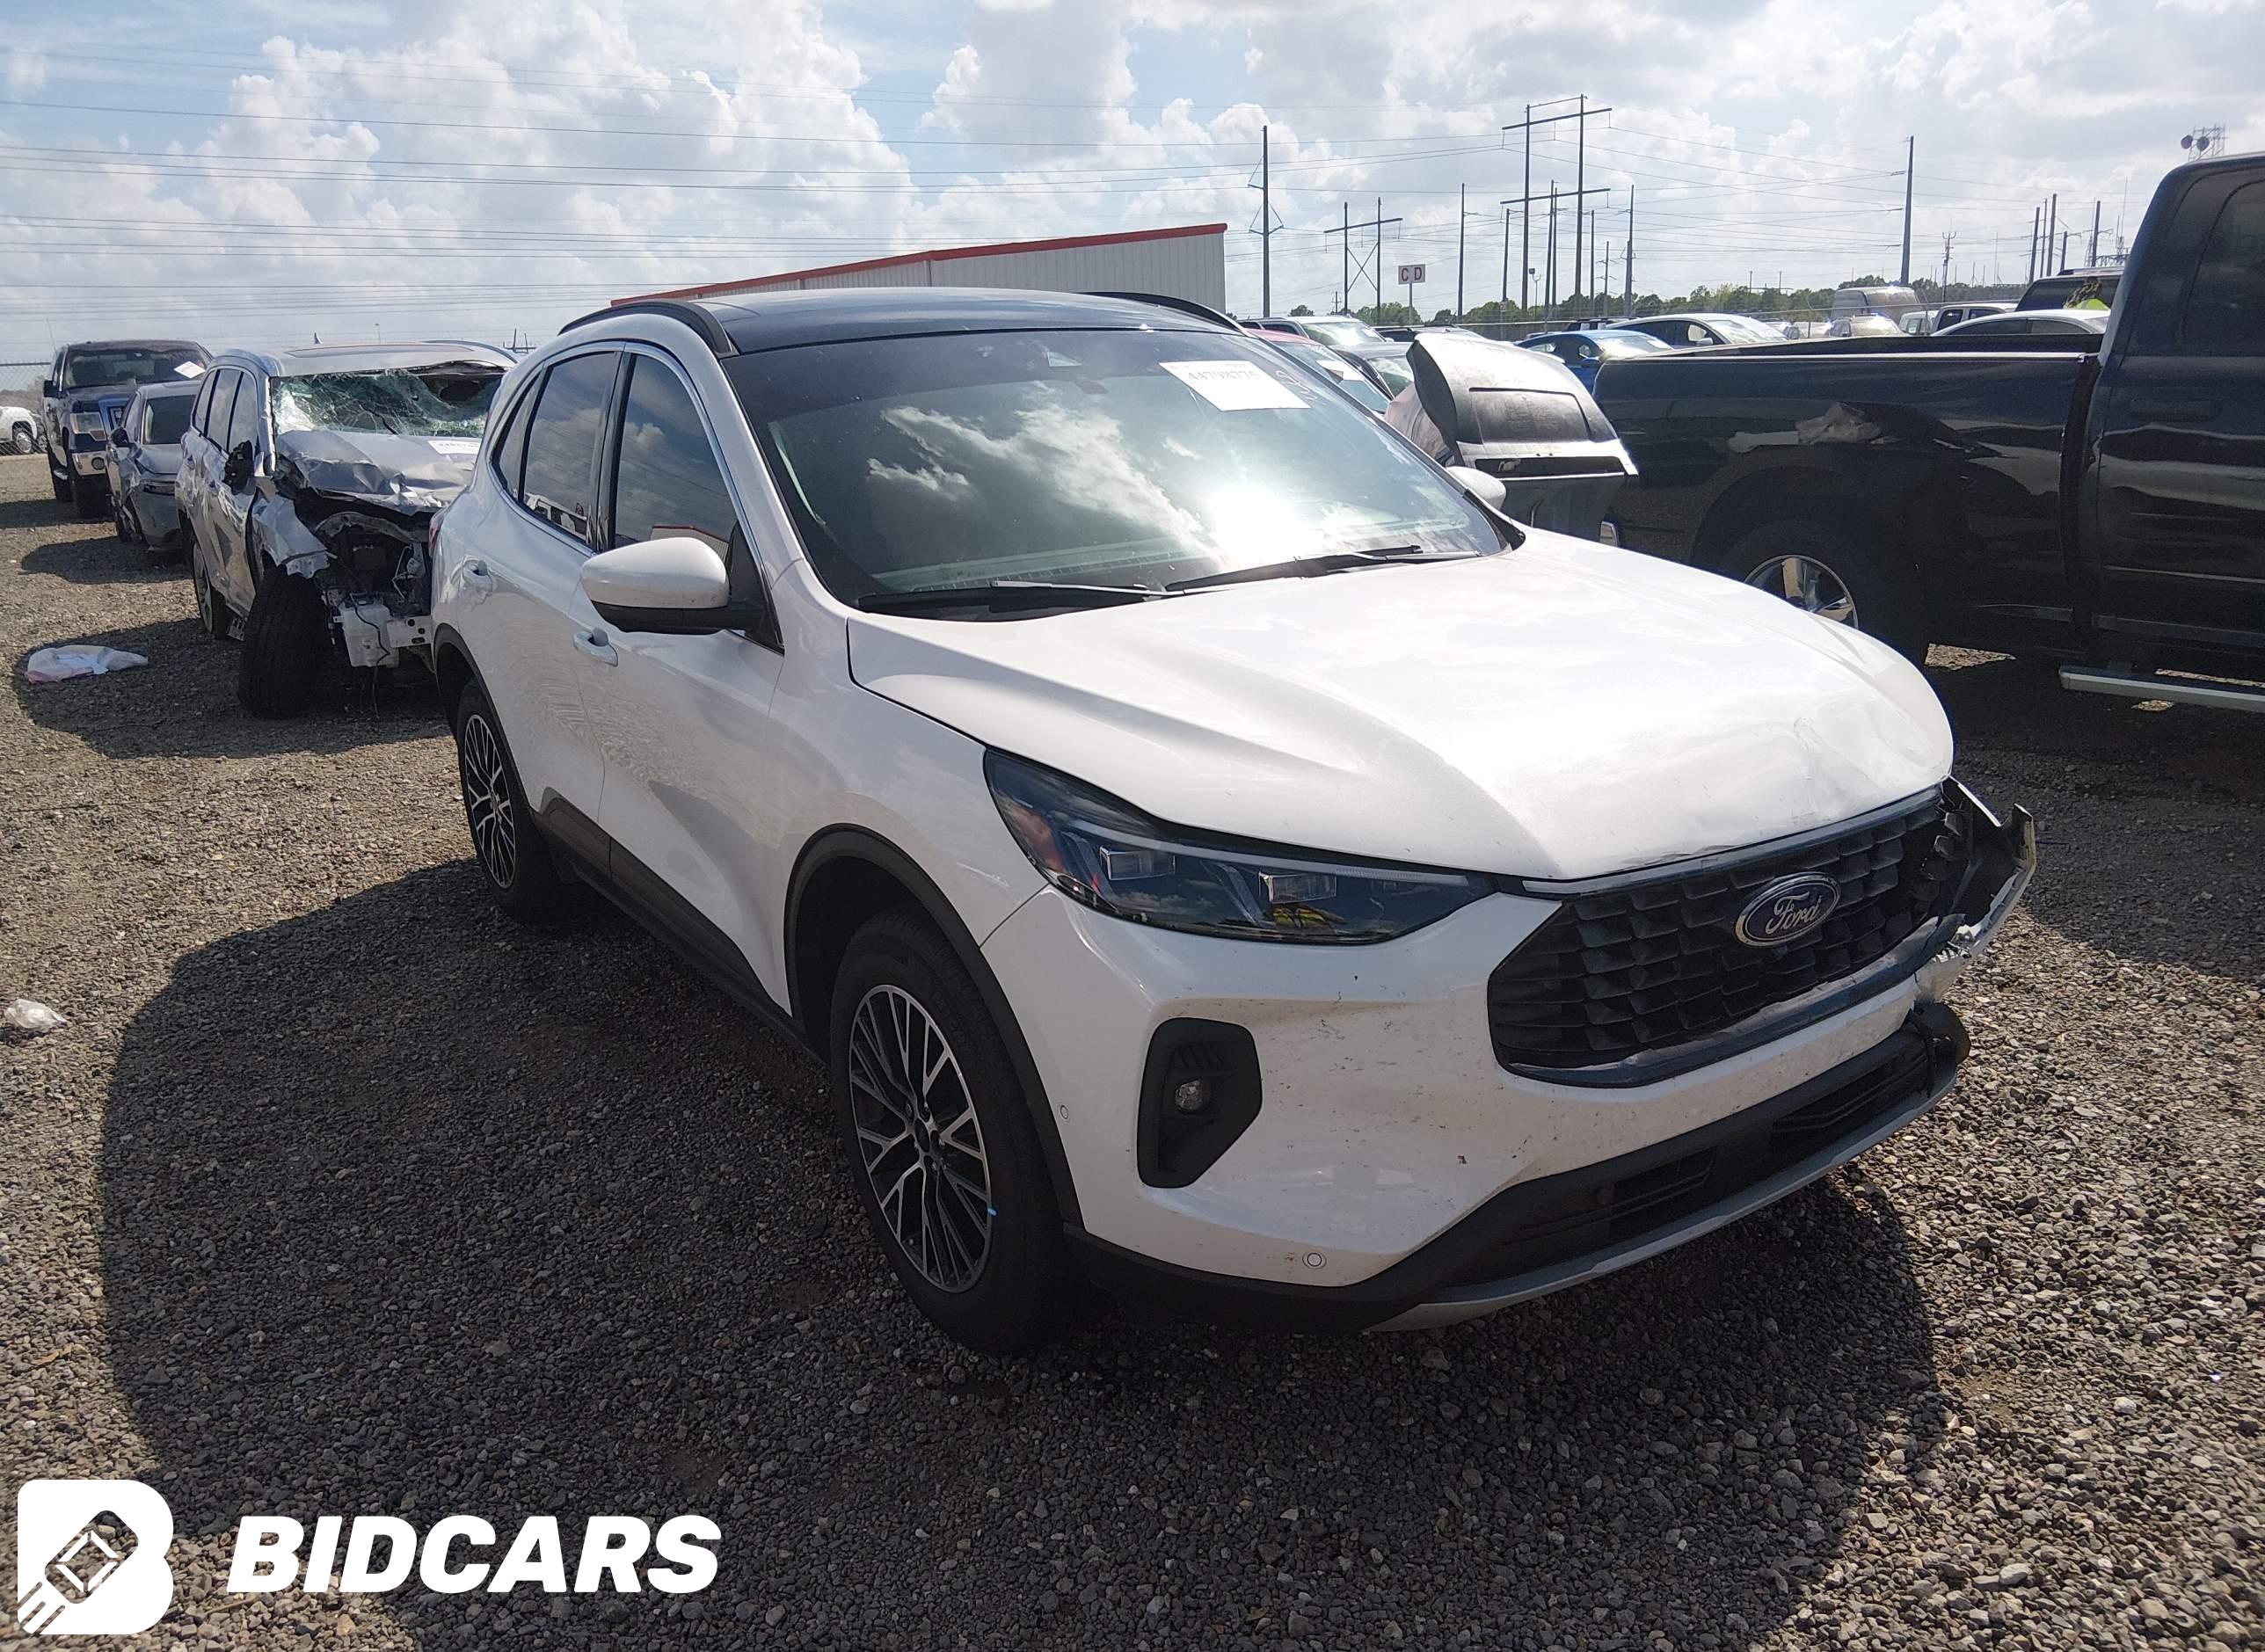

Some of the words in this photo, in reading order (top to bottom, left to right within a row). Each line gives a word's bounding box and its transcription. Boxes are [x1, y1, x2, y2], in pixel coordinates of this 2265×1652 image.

[1401, 267, 1409, 281] C
[1414, 266, 1423, 280] D
[1765, 891, 1823, 935] Ford
